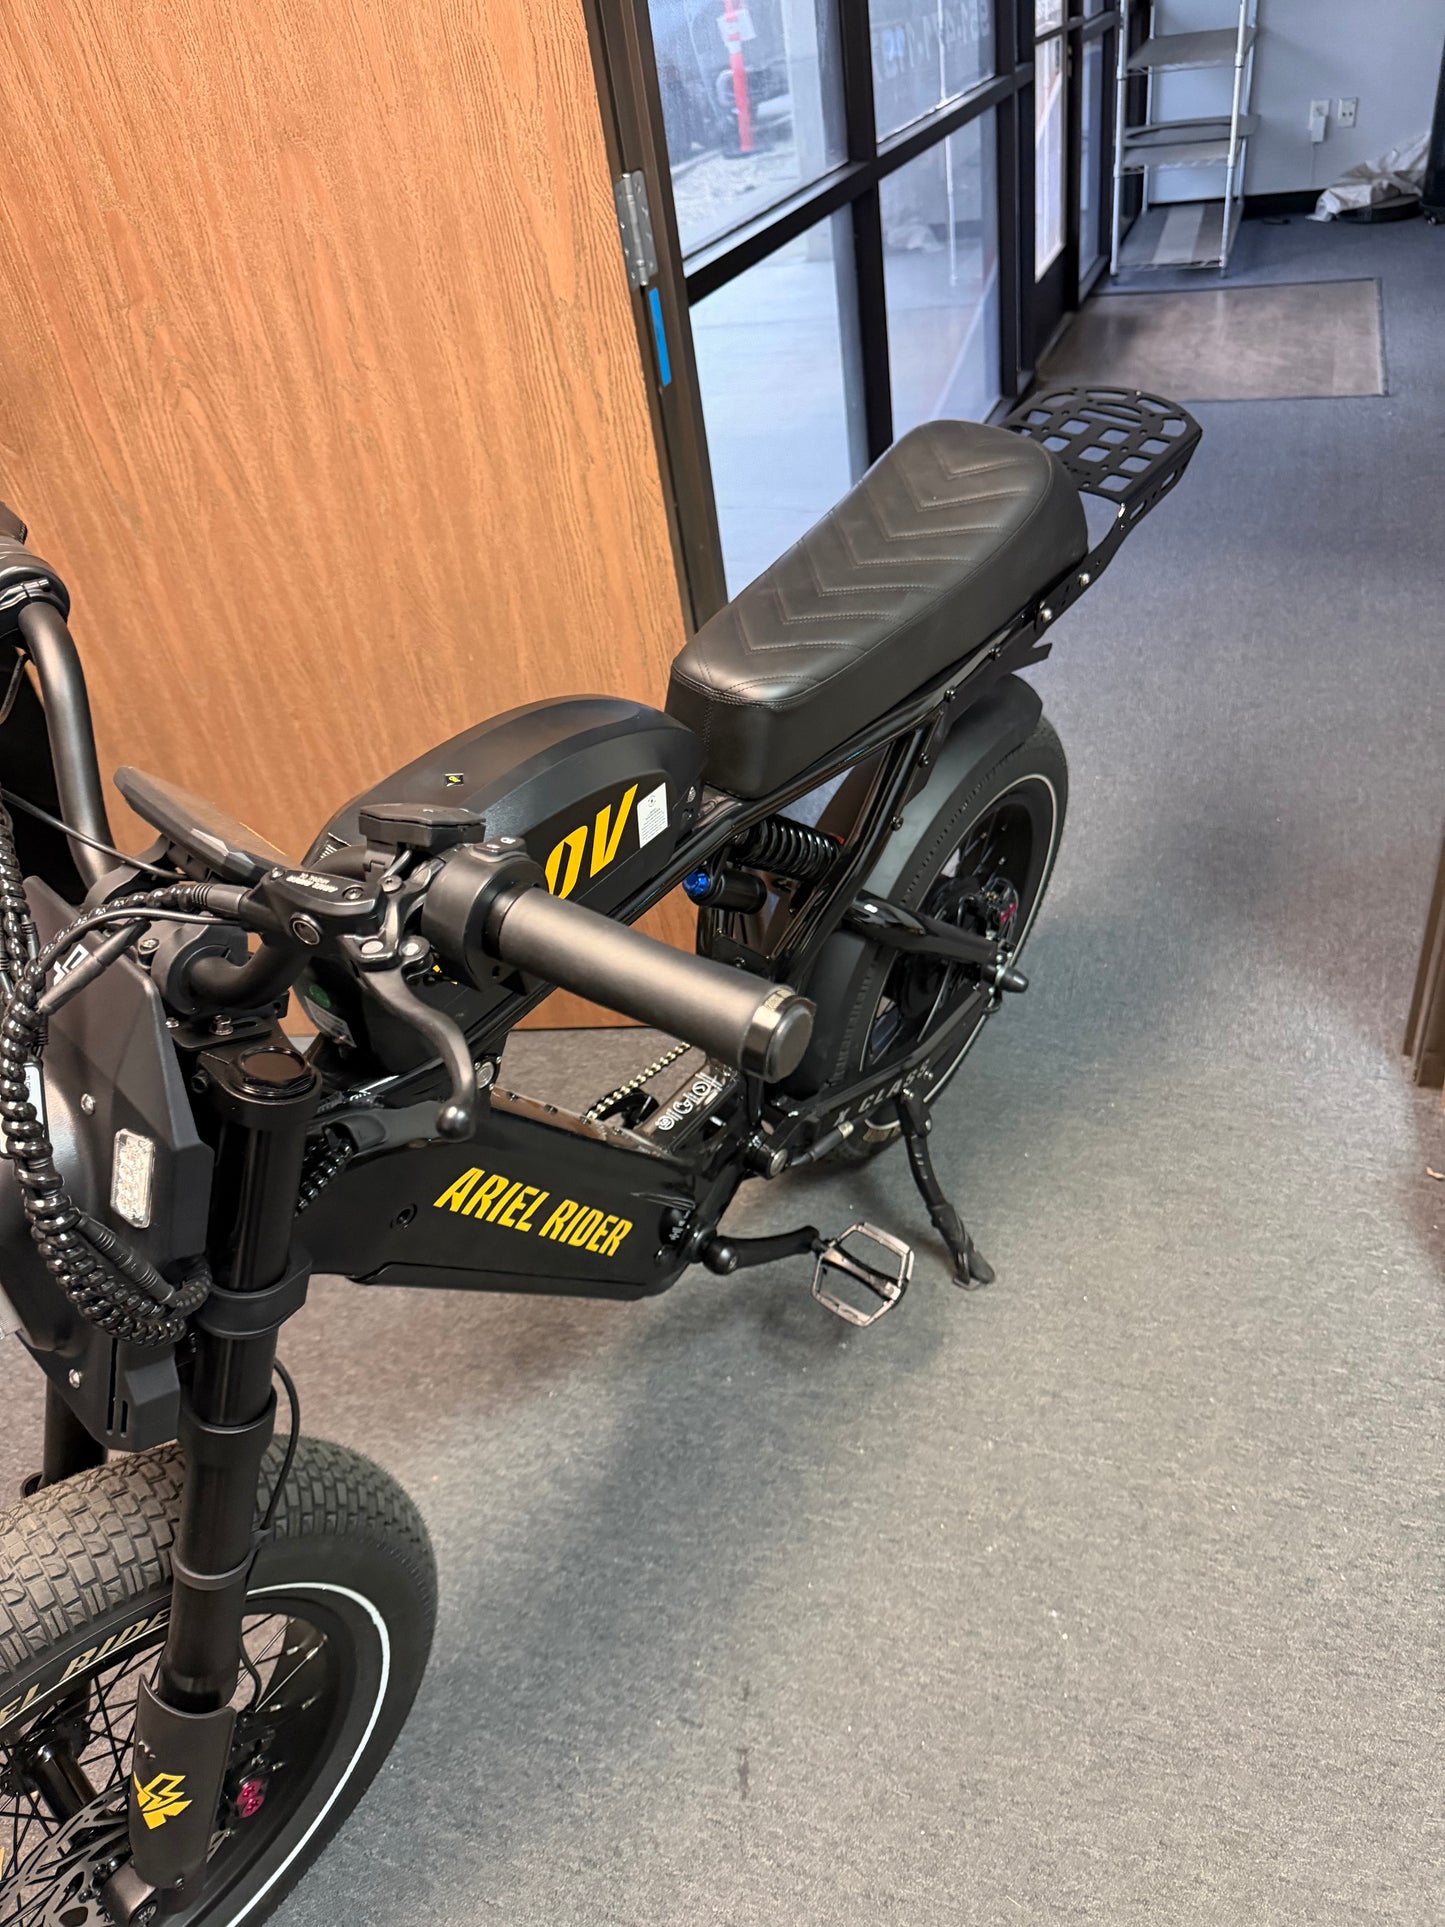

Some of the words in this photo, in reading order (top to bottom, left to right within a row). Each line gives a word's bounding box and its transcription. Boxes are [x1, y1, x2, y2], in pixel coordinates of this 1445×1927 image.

[433, 1166, 550, 1233] ARIEL
[538, 1199, 634, 1257] RIDER
[59, 1607, 171, 1683] RIDE
